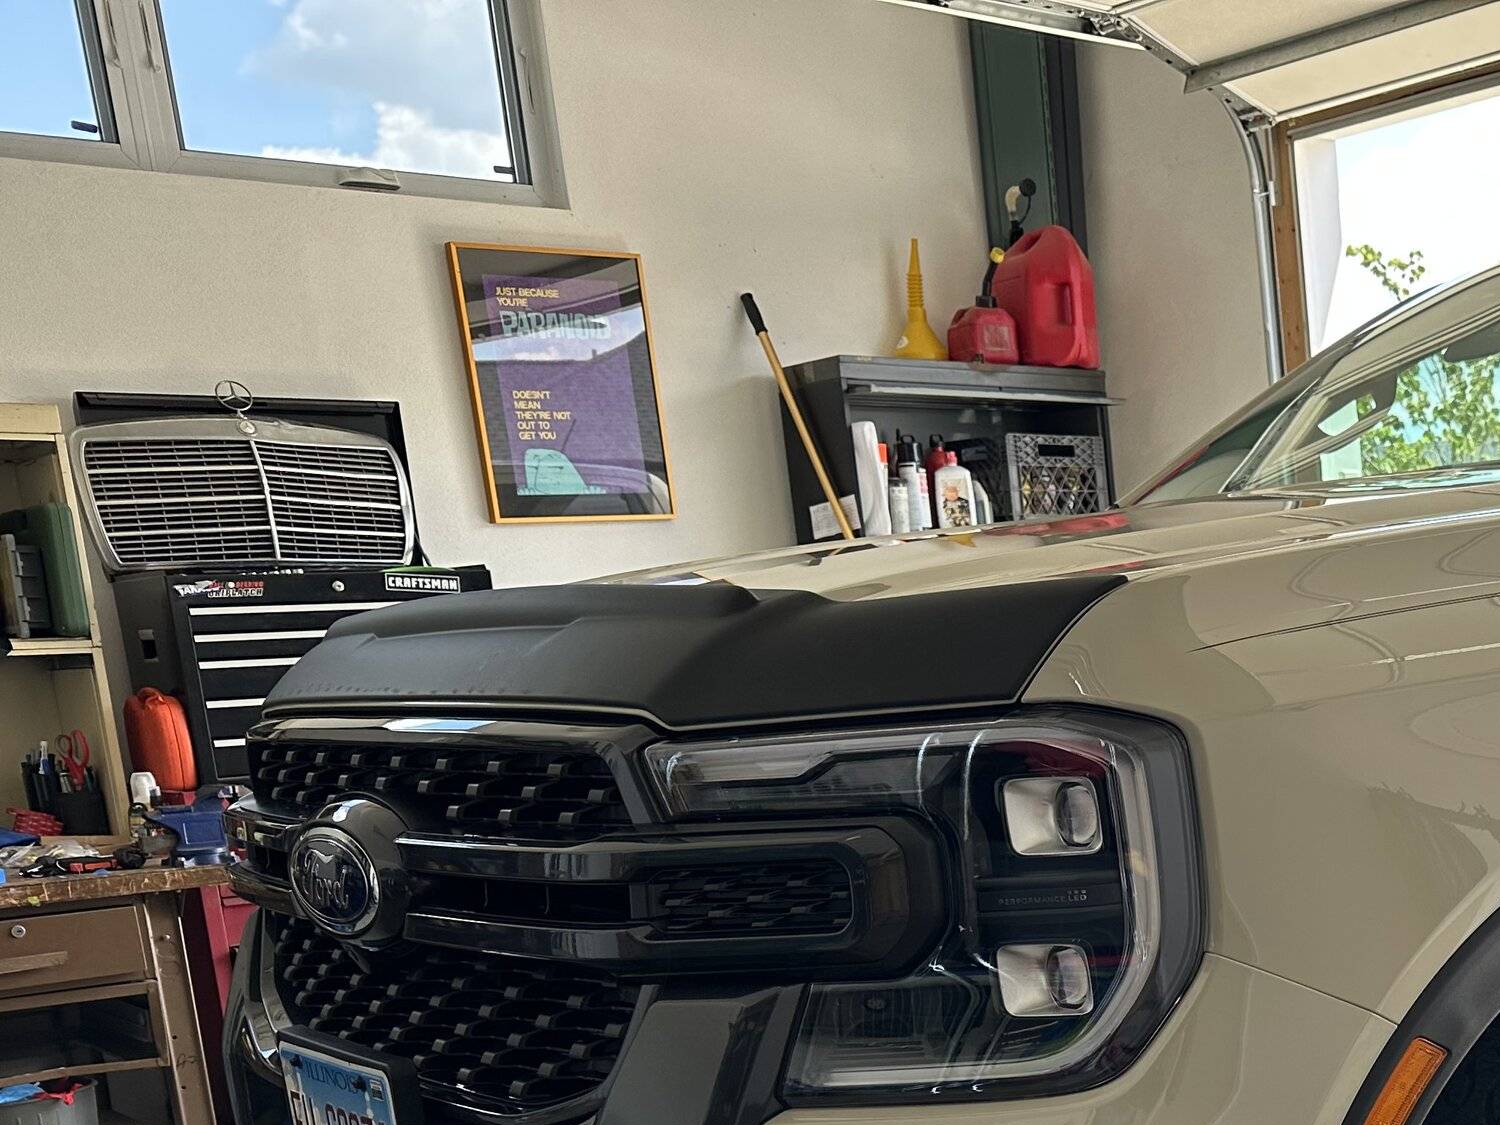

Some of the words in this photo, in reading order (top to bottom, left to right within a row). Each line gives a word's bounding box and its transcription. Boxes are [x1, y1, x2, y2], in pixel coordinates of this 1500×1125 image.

[496, 287, 516, 296] JUST
[518, 288, 560, 298] BECAUSE
[512, 390, 550, 399] DOESN'T
[514, 401, 541, 409] MEAN
[515, 411, 552, 420] THEY'RE
[553, 411, 571, 420] NOT
[517, 421, 535, 430] OUT
[538, 421, 550, 430] TO
[519, 431, 536, 440] GET
[538, 431, 557, 440] YOU
[387, 576, 458, 590] CRAFTSMAN
